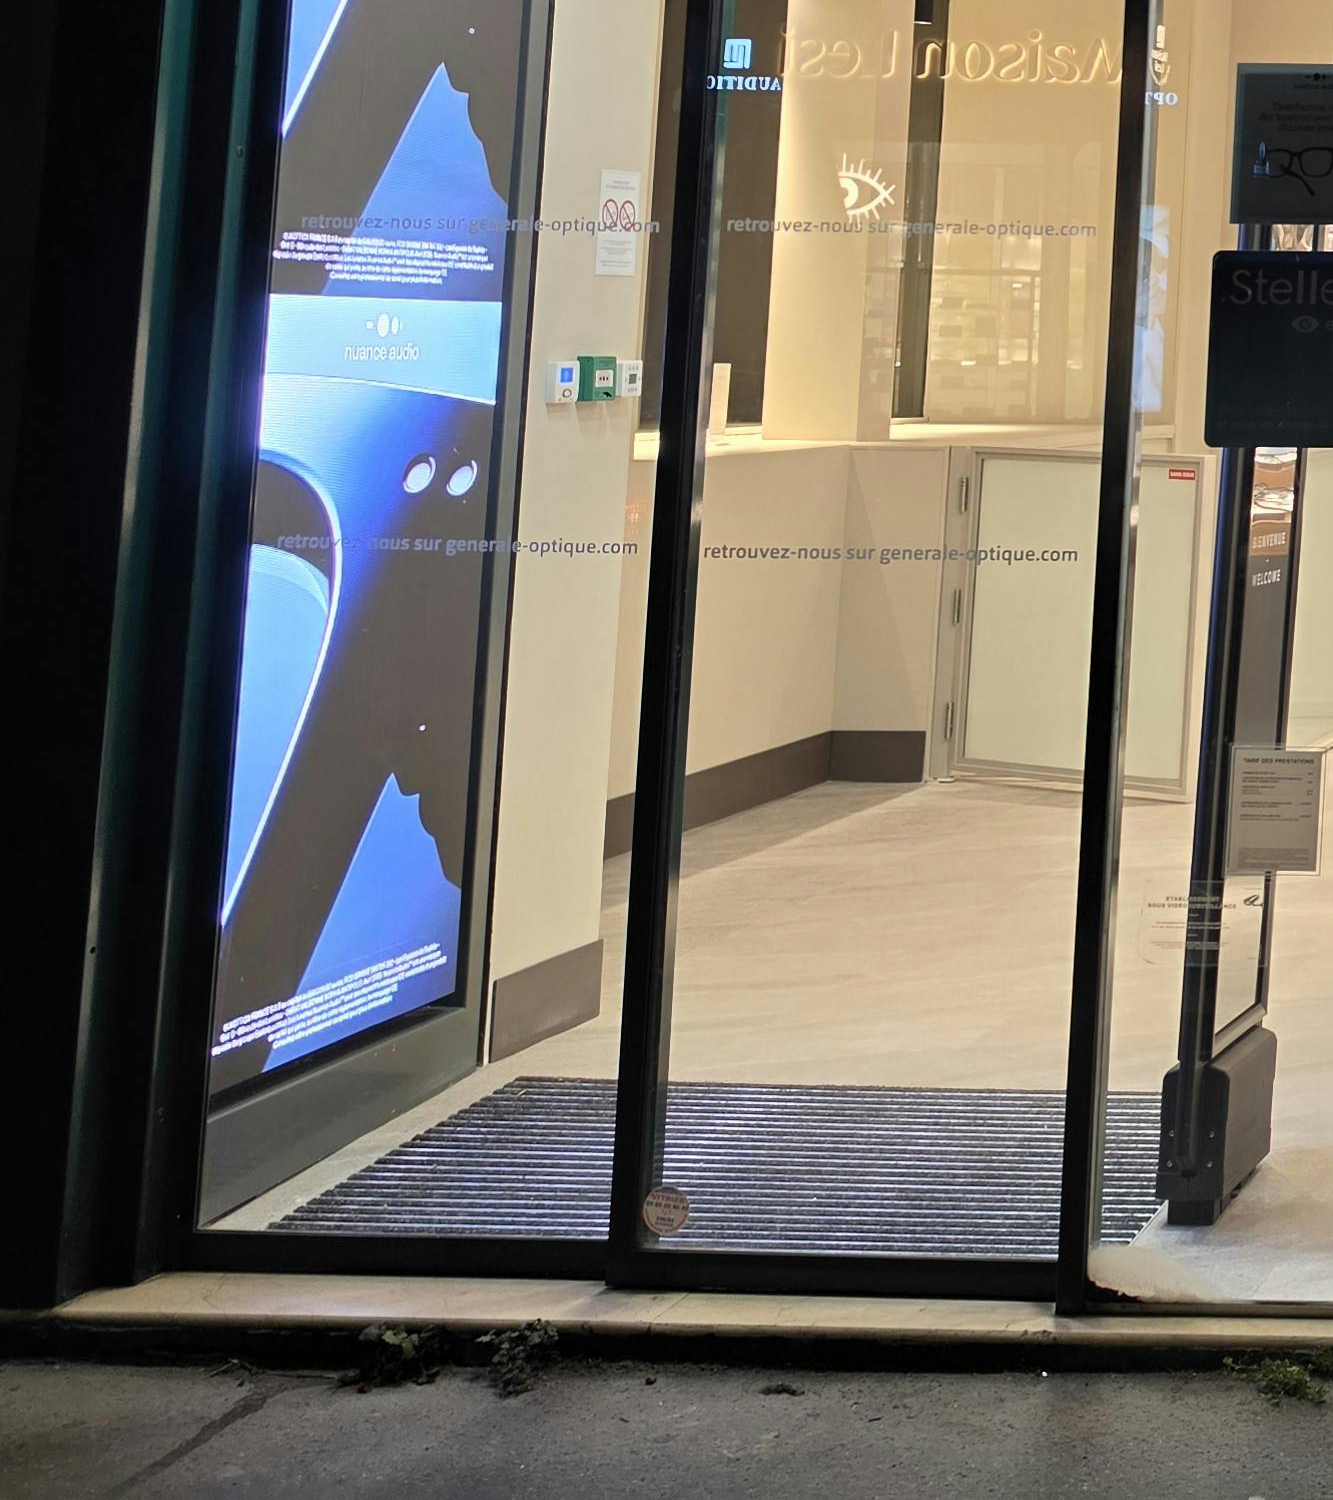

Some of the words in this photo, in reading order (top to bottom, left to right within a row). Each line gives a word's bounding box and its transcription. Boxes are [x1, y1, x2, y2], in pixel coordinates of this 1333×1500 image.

[301, 215, 432, 232] retrouvez-nous
[437, 217, 466, 232] sur
[469, 216, 660, 237] generale-optique.com
[727, 216, 863, 234] retrouvez-nous
[902, 219, 1097, 240] generale-optique.com
[344, 345, 387, 361] nuance
[388, 344, 419, 362] audio
[414, 537, 442, 552] sur
[445, 536, 639, 558] generale-optique.com
[703, 543, 841, 560] retrouvez-nous
[846, 546, 876, 560] sur
[880, 543, 1079, 565] generale-optique.com
